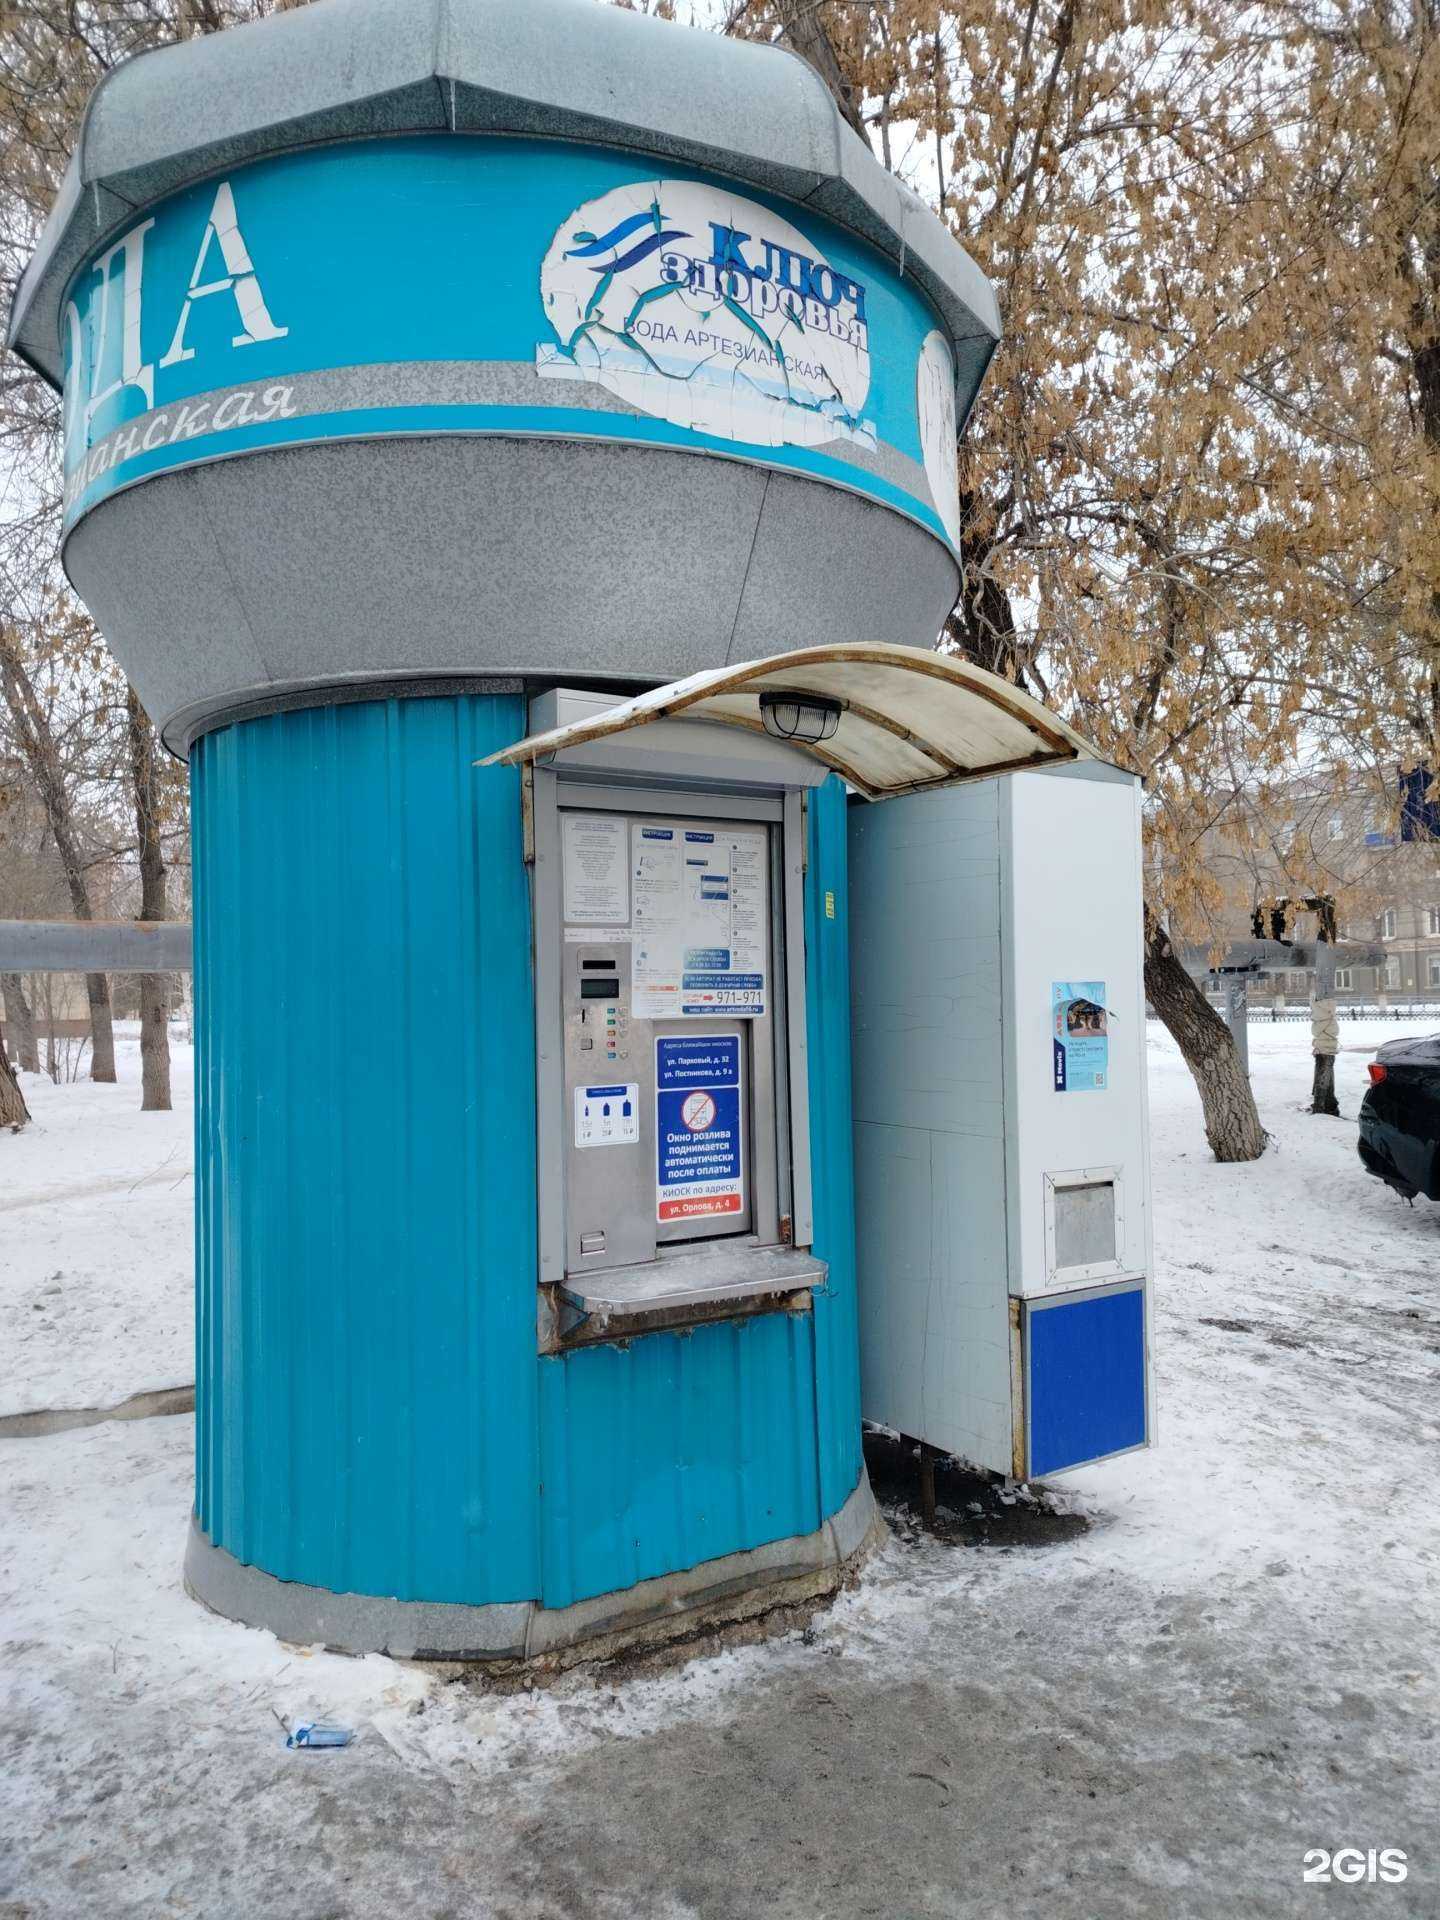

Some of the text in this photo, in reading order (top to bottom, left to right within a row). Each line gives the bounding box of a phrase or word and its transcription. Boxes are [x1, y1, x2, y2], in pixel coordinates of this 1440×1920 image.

[709, 221, 866, 324] КЛЮЧ
[684, 329, 824, 380] АРТЕЗИАНСКАЯ
[717, 991, 761, 1004] 971-971
[678, 1056, 712, 1065] Парковый,
[715, 1069, 721, 1077] д.
[667, 1130, 731, 1143] Окно розлива
[669, 1142, 730, 1155] поднимается
[665, 1154, 734, 1167] автоматически
[668, 1165, 731, 1178] после оплаты
[663, 1184, 737, 1198] КИОСК по адресу:
[670, 1199, 730, 1214] ул. Орлова, д. 4
